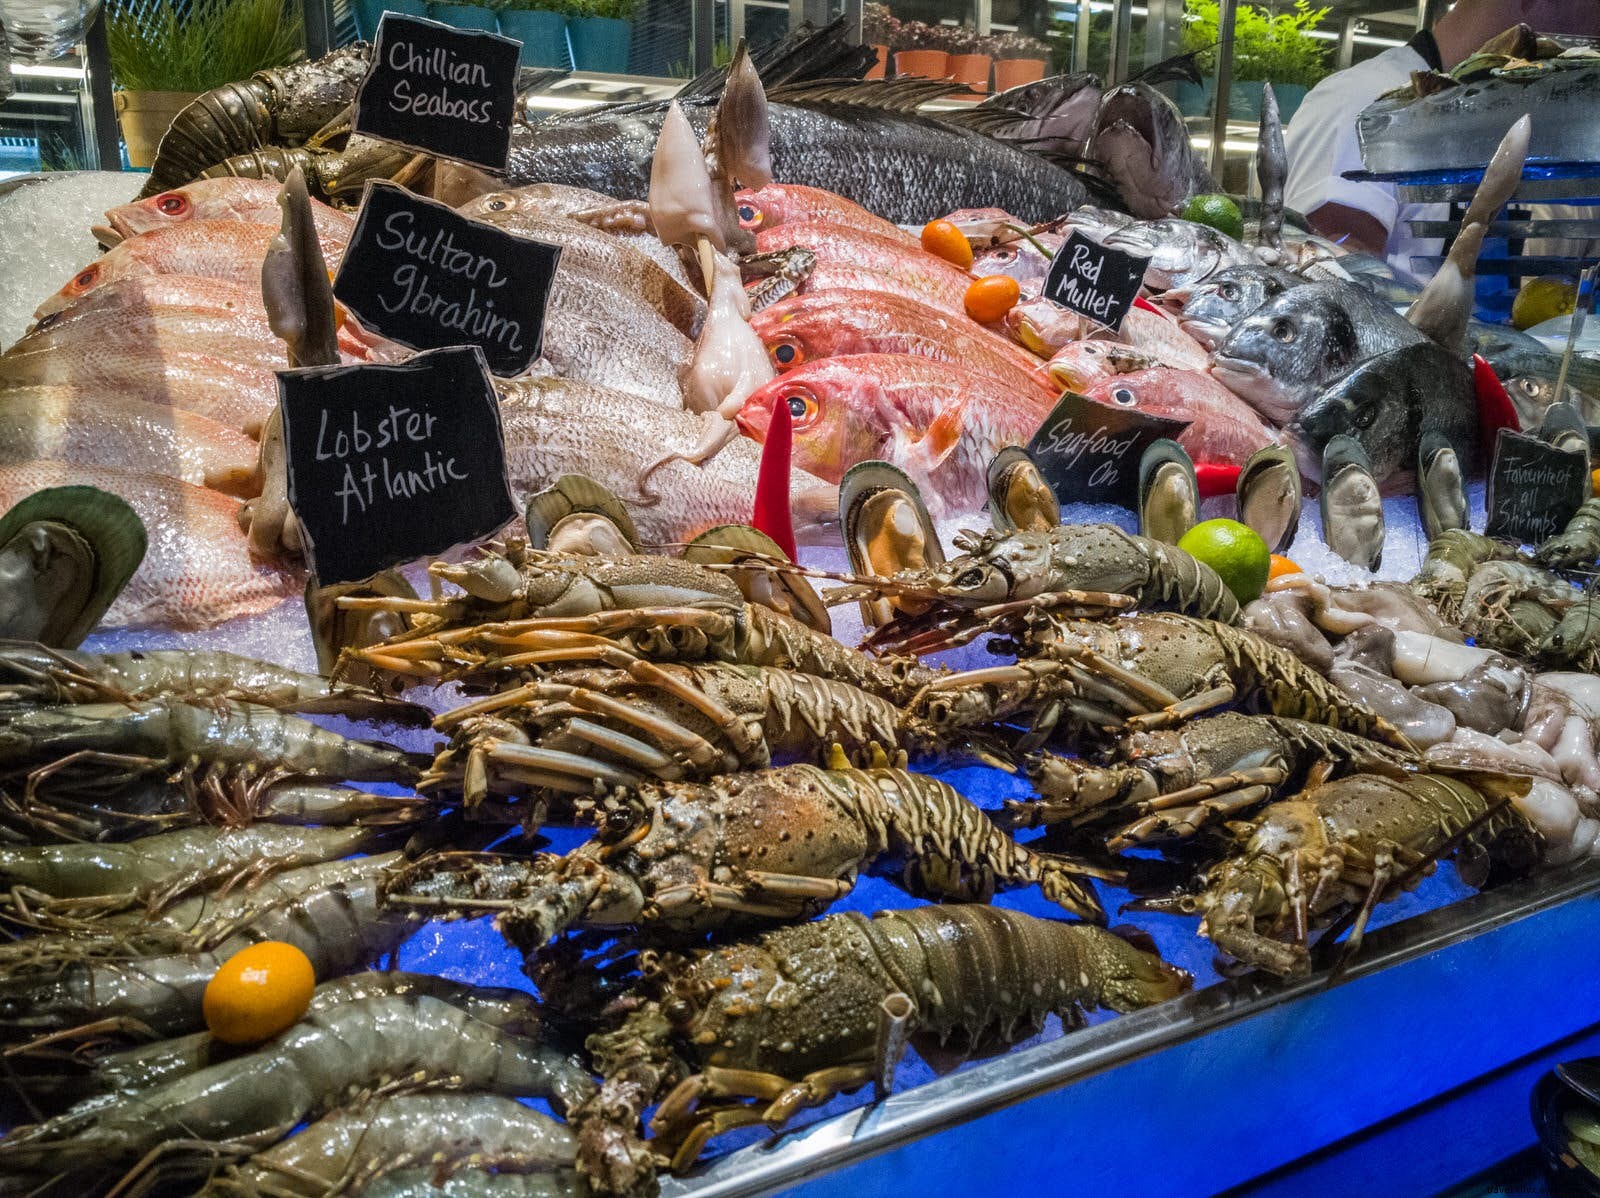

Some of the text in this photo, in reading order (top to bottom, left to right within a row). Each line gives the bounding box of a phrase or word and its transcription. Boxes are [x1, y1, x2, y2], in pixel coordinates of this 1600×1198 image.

[389, 41, 491, 88] Chillian
[376, 211, 507, 288] Sultan
[1070, 244, 1104, 285] Red
[315, 405, 438, 461] Lobster
[1036, 418, 1141, 470] Seafood
[335, 451, 469, 525] Atlantic
[1088, 460, 1120, 487] On
